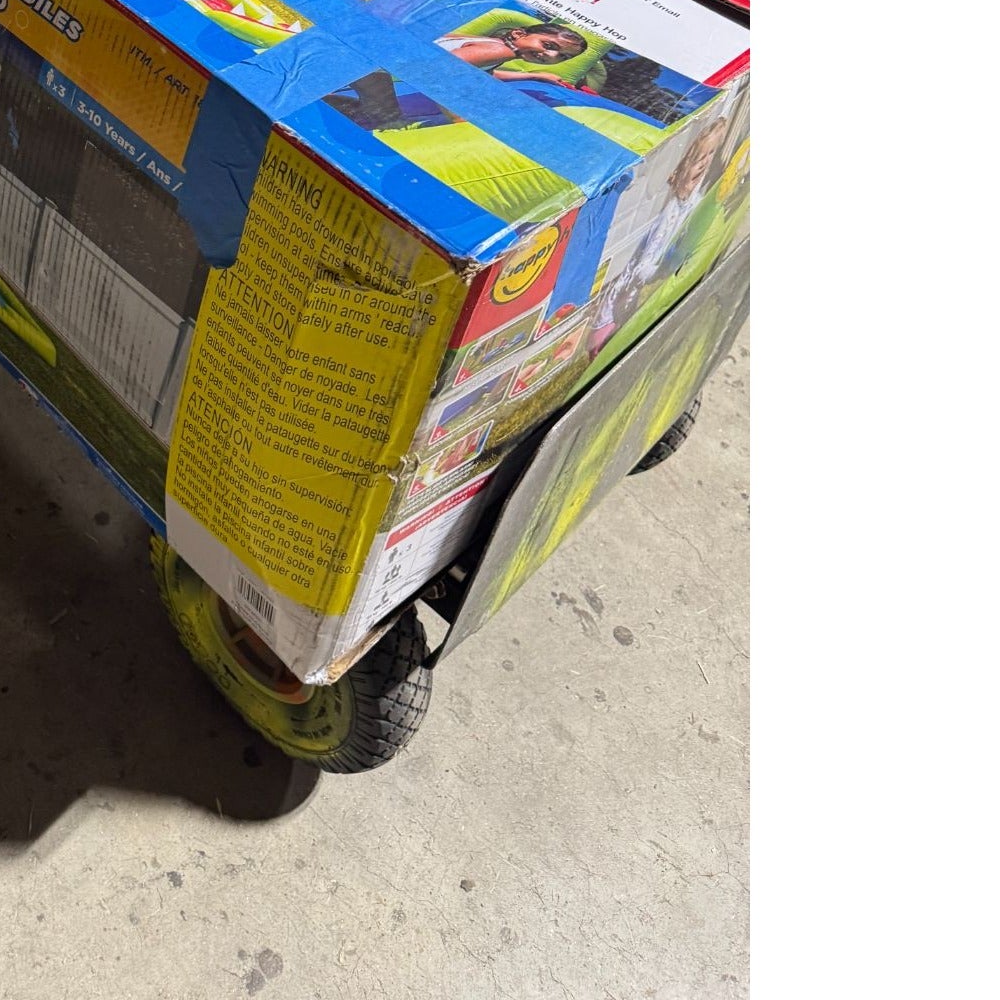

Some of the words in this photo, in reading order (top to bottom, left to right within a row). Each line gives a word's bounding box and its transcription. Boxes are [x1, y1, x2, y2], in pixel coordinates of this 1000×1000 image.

[564, 5, 602, 29] Happy
[602, 26, 627, 42] Hop
[651, 0, 681, 19] Email
[76, 100, 103, 127] 3-10
[105, 121, 137, 156] Years
[146, 160, 172, 186] Ans
[289, 195, 313, 225] have
[313, 217, 360, 257] drowned
[361, 252, 372, 268] in
[289, 221, 317, 253] pools.
[291, 244, 303, 260] at
[302, 253, 316, 271] all
[218, 268, 295, 341] ATTENTION
[253, 274, 273, 295] and
[272, 290, 297, 316] store
[297, 311, 333, 334] safely
[334, 321, 364, 340] after
[365, 331, 391, 350] use.
[255, 252, 279, 281] keep
[280, 272, 303, 302] them
[303, 296, 338, 316] within
[340, 306, 372, 325] arms
[354, 292, 368, 305] or
[369, 297, 416, 319] around
[416, 307, 437, 327] the
[206, 316, 237, 348] enfants
[236, 343, 271, 377] peuvent
[270, 371, 283, 387] se
[283, 379, 315, 399] noyer
[316, 390, 343, 410] dans
[344, 401, 367, 418] une
[210, 301, 258, 347] surveillance
[264, 343, 299, 376] Danger
[299, 367, 314, 382] de
[315, 374, 359, 397] noyade.
[365, 387, 388, 407] Les
[214, 282, 227, 301] Ne
[226, 294, 255, 326] jamais
[255, 316, 283, 348] laisser
[285, 345, 311, 363] votre
[312, 355, 348, 376] enfant
[349, 366, 377, 385] sans
[188, 391, 253, 455] ATENCIÓN
[192, 374, 203, 389] de
[203, 382, 241, 422] l'asphalte
[241, 418, 254, 433] ou
[254, 427, 272, 447] tout
[273, 440, 300, 459] autre
[301, 452, 359, 483] revêtement
[195, 358, 208, 377] Ne
[206, 372, 223, 391] pas
[224, 382, 257, 417] installer
[265, 421, 320, 451] pataugette
[322, 444, 341, 458] sur
[341, 450, 356, 465] du
[199, 343, 238, 386] lorsqu'elle
[239, 380, 259, 404] n'est
[259, 399, 277, 418] pas
[278, 411, 317, 434] utilisée.
[205, 330, 228, 358] faible
[227, 352, 261, 386] quantité
[260, 380, 288, 407] d'eau.
[293, 396, 320, 417] Vider
[321, 407, 332, 423] la
[333, 414, 392, 444] pataugette
[181, 427, 196, 449] Los
[218, 467, 251, 498] pueden
[251, 494, 300, 524] ahogarse
[301, 519, 315, 532] en
[316, 525, 337, 542] una
[182, 418, 211, 448] peligro
[211, 443, 223, 458] de
[223, 454, 285, 502] ahogamiento.
[185, 403, 213, 435] Nunca
[213, 429, 231, 451] deje
[239, 454, 252, 468] su
[251, 461, 270, 481] hijo
[271, 474, 288, 488] sin
[175, 464, 187, 482] No
[187, 477, 213, 507] instale
[221, 510, 252, 541] piscina
[252, 535, 286, 561] infantil
[285, 555, 316, 577] sobre
[179, 444, 213, 479] cantidad
[212, 474, 231, 496] muy
[231, 491, 271, 525] pequeña
[272, 518, 286, 533] de
[184, 463, 213, 493] piscina
[213, 488, 241, 518] infantil
[241, 514, 276, 542] cuando
[277, 536, 292, 550] no
[292, 544, 316, 562] esté
[316, 555, 331, 569] en
[211, 513, 240, 542] asfalto
[247, 545, 291, 577] cualquier
[290, 571, 312, 589] otra
